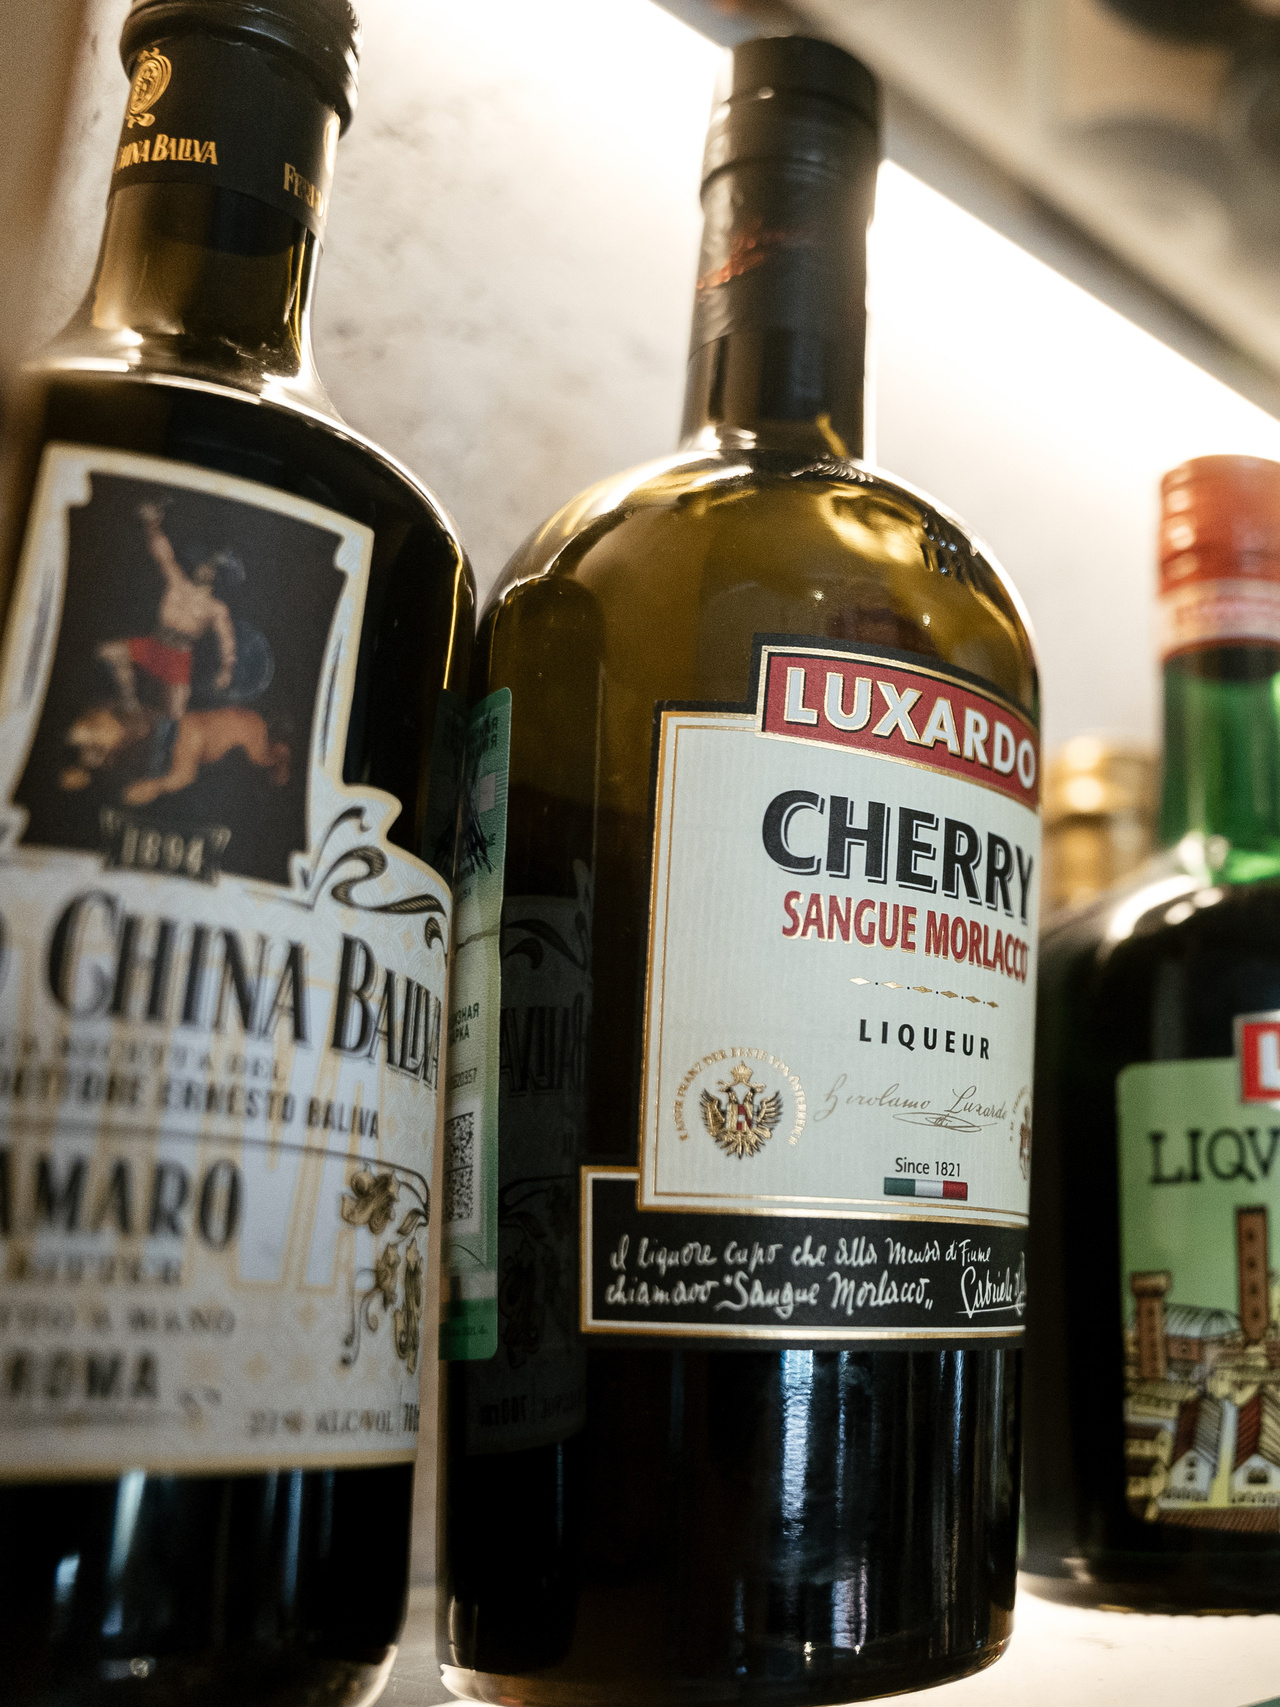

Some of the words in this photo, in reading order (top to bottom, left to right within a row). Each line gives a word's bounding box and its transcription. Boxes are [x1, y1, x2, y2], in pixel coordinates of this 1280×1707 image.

[783, 666, 1036, 790] LUXARDO
[762, 789, 1033, 926] CHERRY
[46, 889, 309, 1050] CHINA
[781, 890, 917, 954] SANGUE
[925, 910, 1028, 985] MORLACCO
[859, 1018, 990, 1060] LIQUEUR
[895, 1157, 930, 1175] Since
[935, 1160, 961, 1178] 1821
